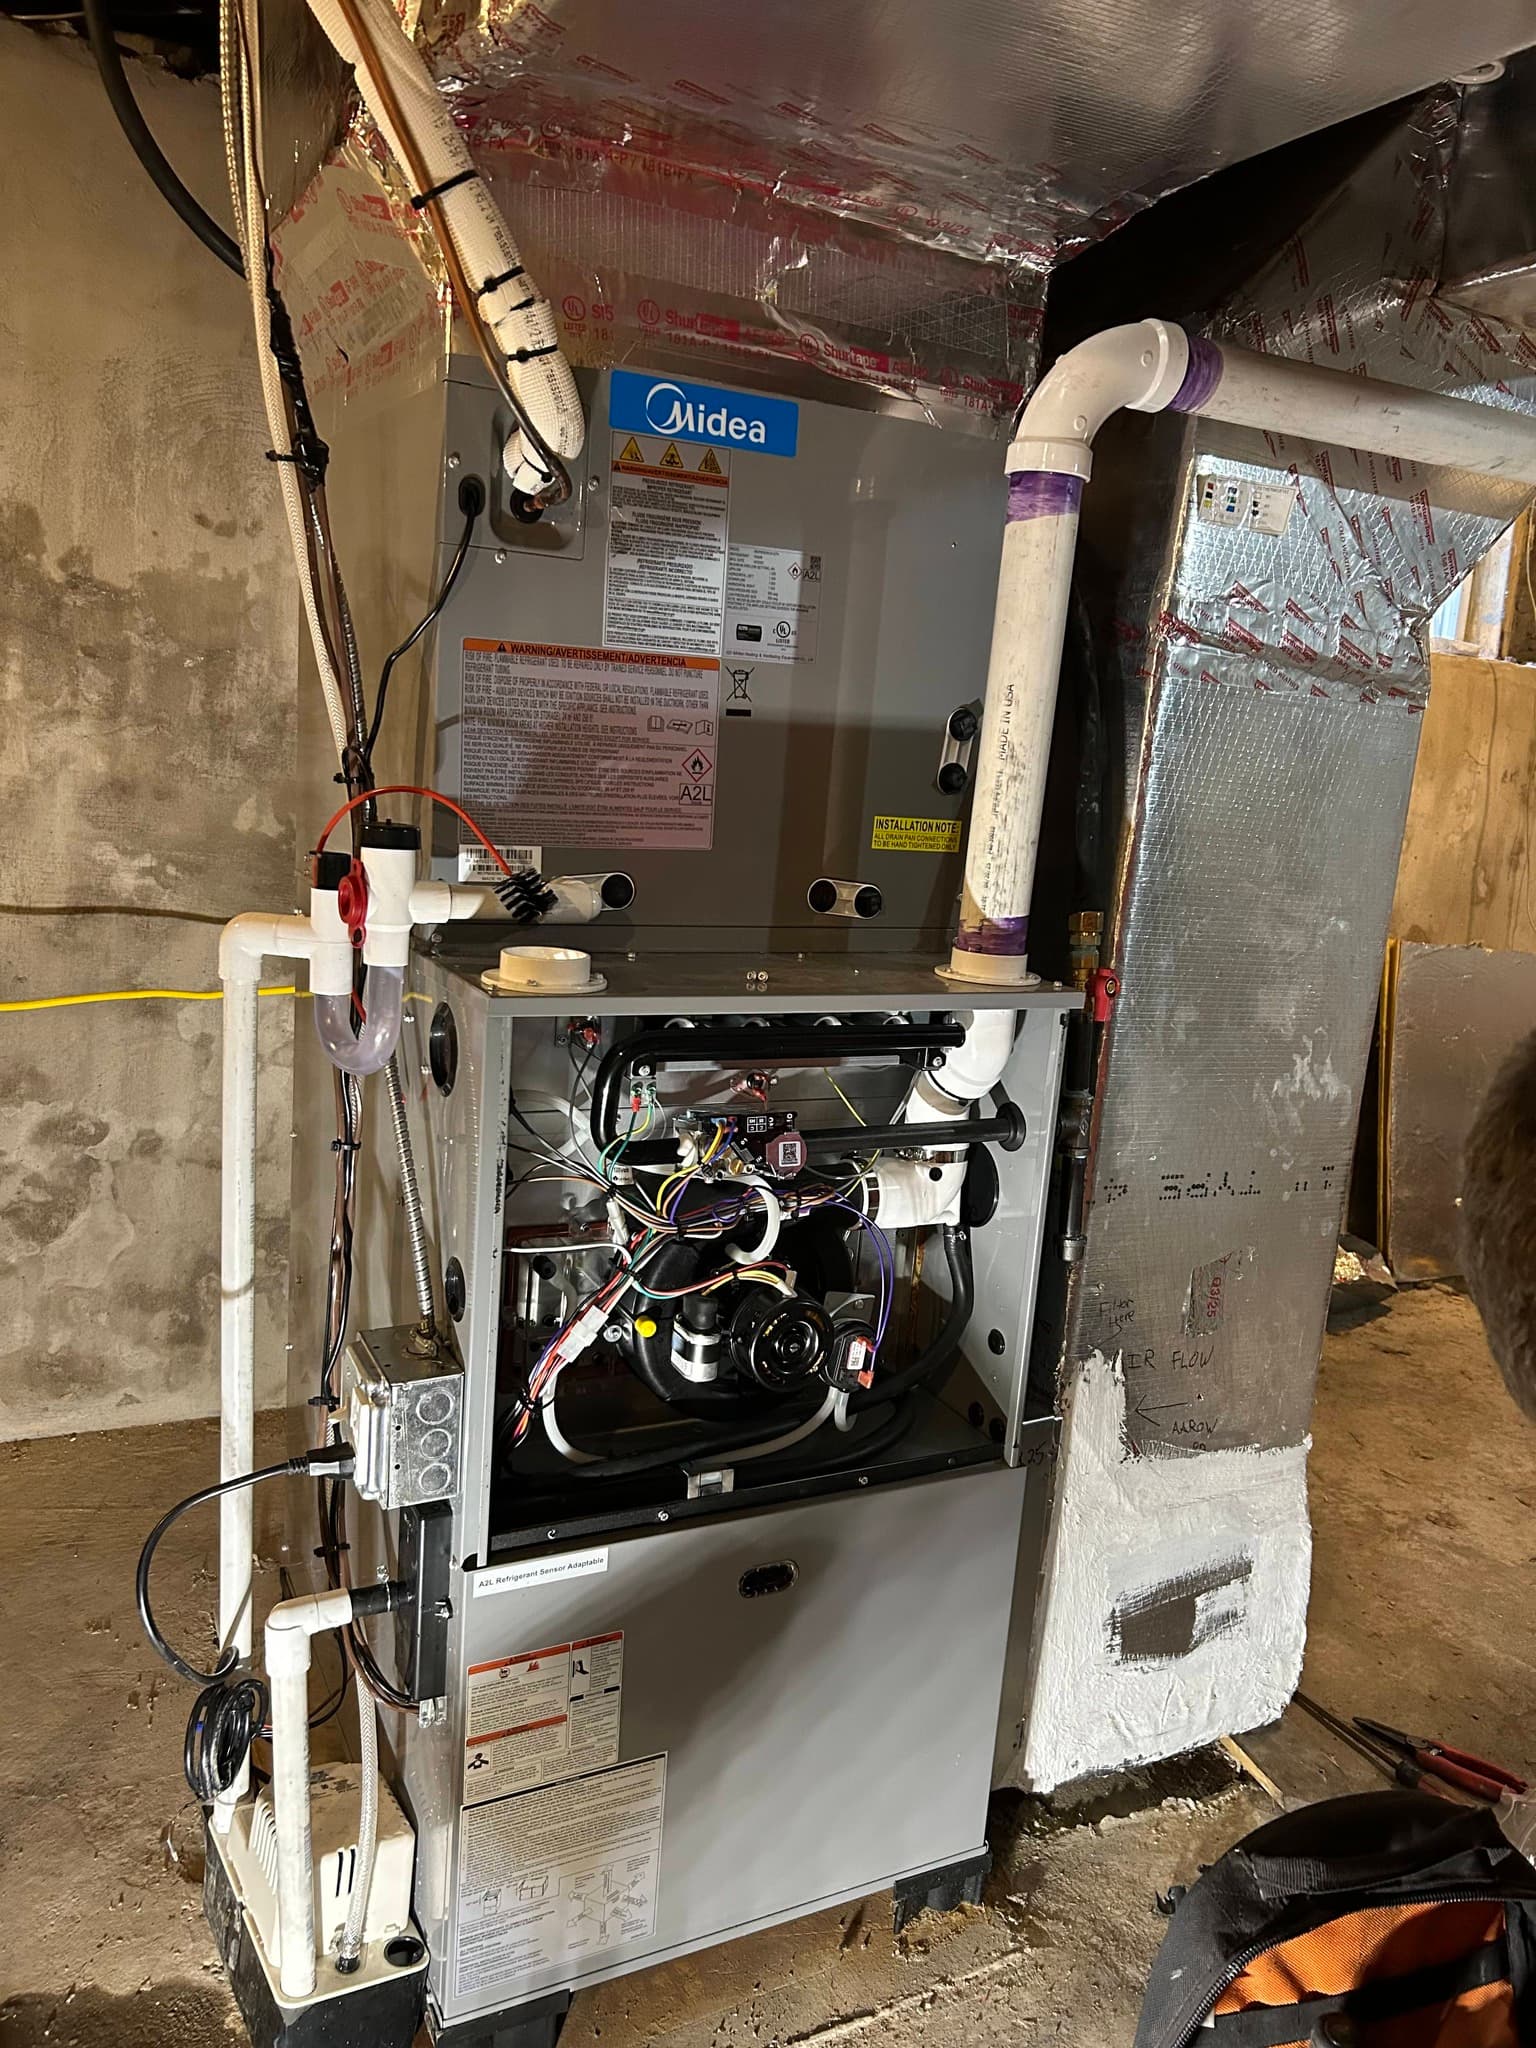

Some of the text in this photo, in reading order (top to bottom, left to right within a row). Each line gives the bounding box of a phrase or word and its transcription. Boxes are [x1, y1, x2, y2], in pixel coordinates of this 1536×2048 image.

[646, 382, 766, 444] Midea
[511, 643, 687, 667] WARNING/AVERTISSEMENT/ADVERTENCIA
[999, 683, 1015, 762] MADE IN USA
[680, 785, 712, 801] A2L
[875, 818, 934, 832] INSTALLATION
[1171, 1345, 1215, 1371] FLOW
[478, 1556, 605, 1588] A2L Refrigerant Sensor Adaptable
